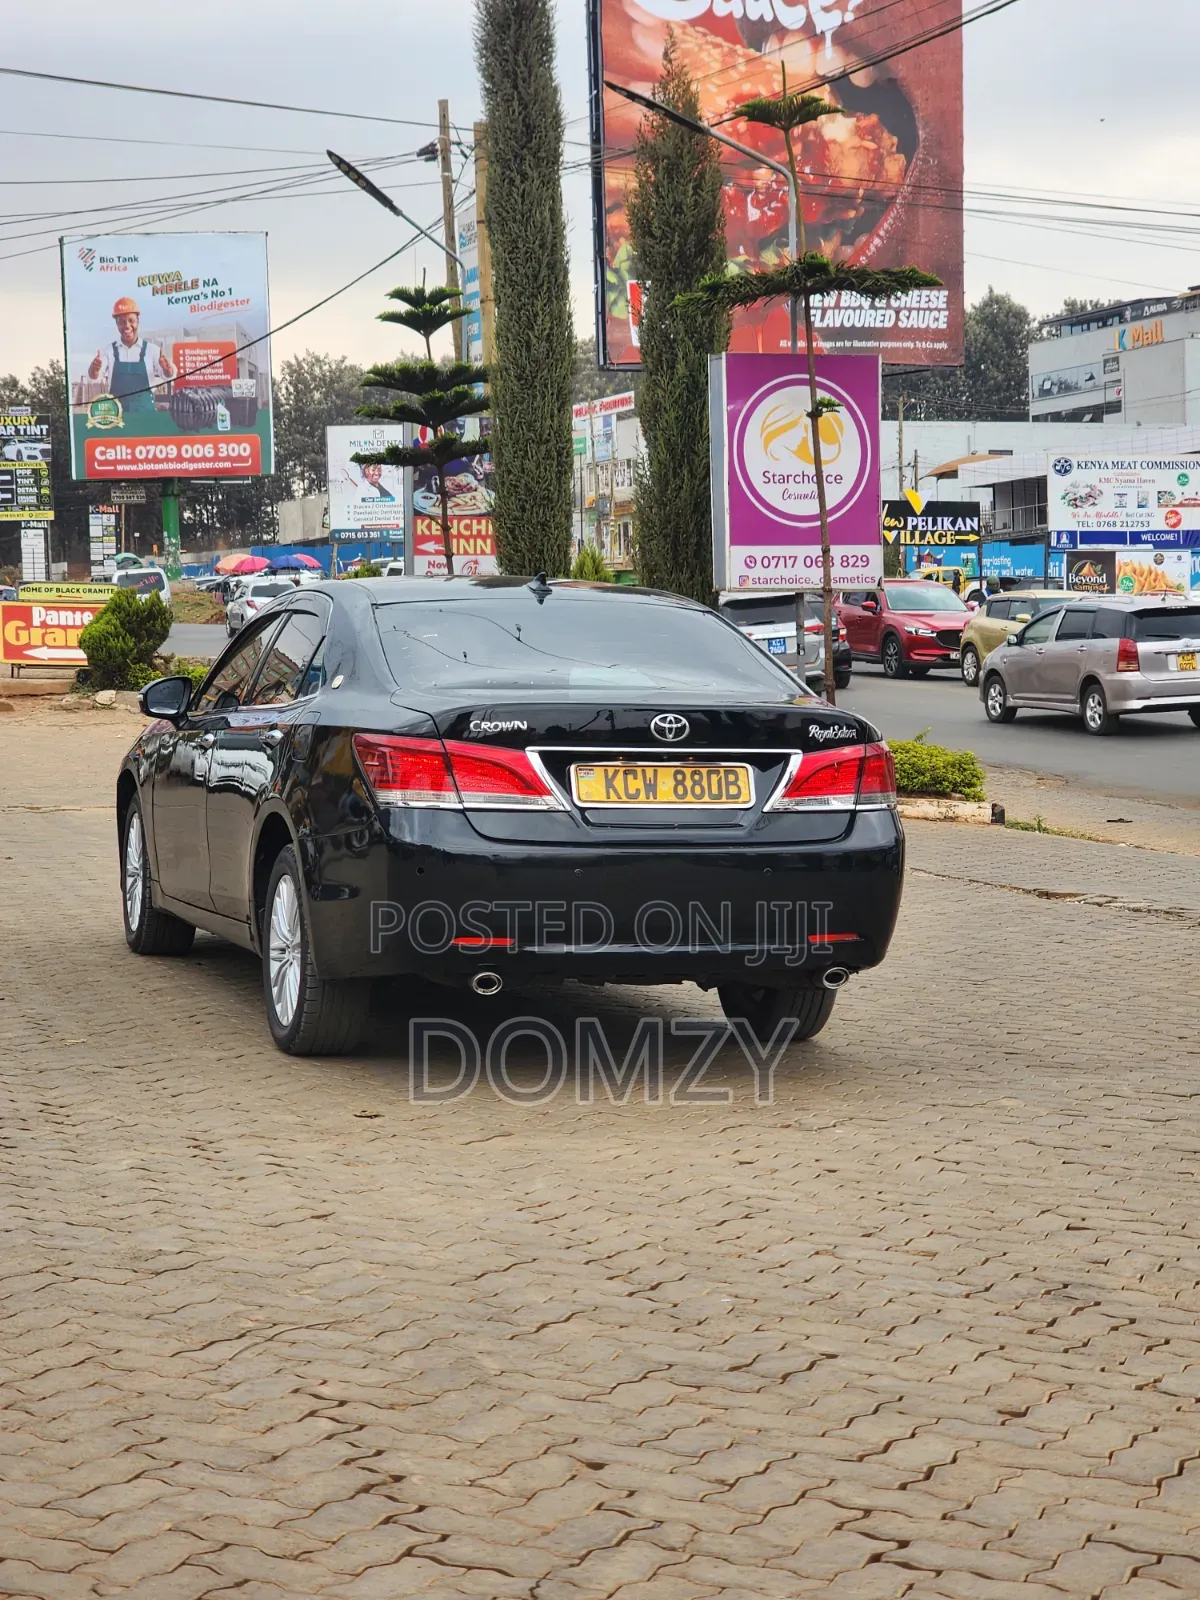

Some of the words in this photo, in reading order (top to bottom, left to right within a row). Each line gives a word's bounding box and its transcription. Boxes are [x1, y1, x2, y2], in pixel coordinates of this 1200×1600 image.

[99, 256, 115, 264] Bio
[116, 254, 139, 263] Tank
[99, 264, 128, 272] Africa
[137, 270, 183, 287] KUWA
[152, 278, 200, 296] MBELE
[202, 278, 219, 288] NA
[167, 292, 209, 305] Kenya's
[211, 290, 226, 299] No
[227, 287, 233, 296] 1
[891, 290, 949, 308] CHEESE
[189, 297, 251, 313] Biodigester
[809, 309, 897, 328] FLAVOURED
[898, 309, 949, 329] SAUCE
[1114, 328, 1127, 350] K
[1131, 320, 1164, 349] Mall
[880, 341, 902, 349] purposes
[933, 341, 949, 350] apply.
[17, 425, 49, 435] TINT
[95, 444, 132, 460] Call:
[135, 444, 178, 460] 0709
[181, 443, 215, 459] 006
[218, 442, 251, 457] 300
[116, 460, 232, 471] www.biotankbiodigester.com
[1076, 460, 1109, 470] KENYA
[1111, 460, 1138, 470] MEAT
[1140, 460, 1200, 470] COMMISSION
[762, 470, 844, 485] Starchoce
[781, 487, 820, 501] Cosmeti
[89, 505, 120, 514] K-Mall
[906, 516, 979, 531] PELIKAN
[1076, 520, 1094, 528] TEL:
[1096, 520, 1118, 528] 0768
[1119, 520, 1151, 528] 212753
[340, 531, 356, 539] 0715
[356, 531, 368, 539] 613
[1140, 533, 1178, 541] WELCOME!
[452, 538, 491, 555] INN
[761, 555, 798, 569] 0717
[840, 554, 870, 568] 829
[467, 565, 477, 575] 24
[1001, 566, 1014, 576] wall
[1015, 567, 1034, 576] water
[751, 574, 877, 585] starchoice._csmetics
[1068, 573, 1107, 584] Beyond
[82, 587, 115, 595] GRANITE
[470, 720, 528, 732] CROWN
[603, 768, 658, 800] KCW
[673, 769, 742, 800] 880B
